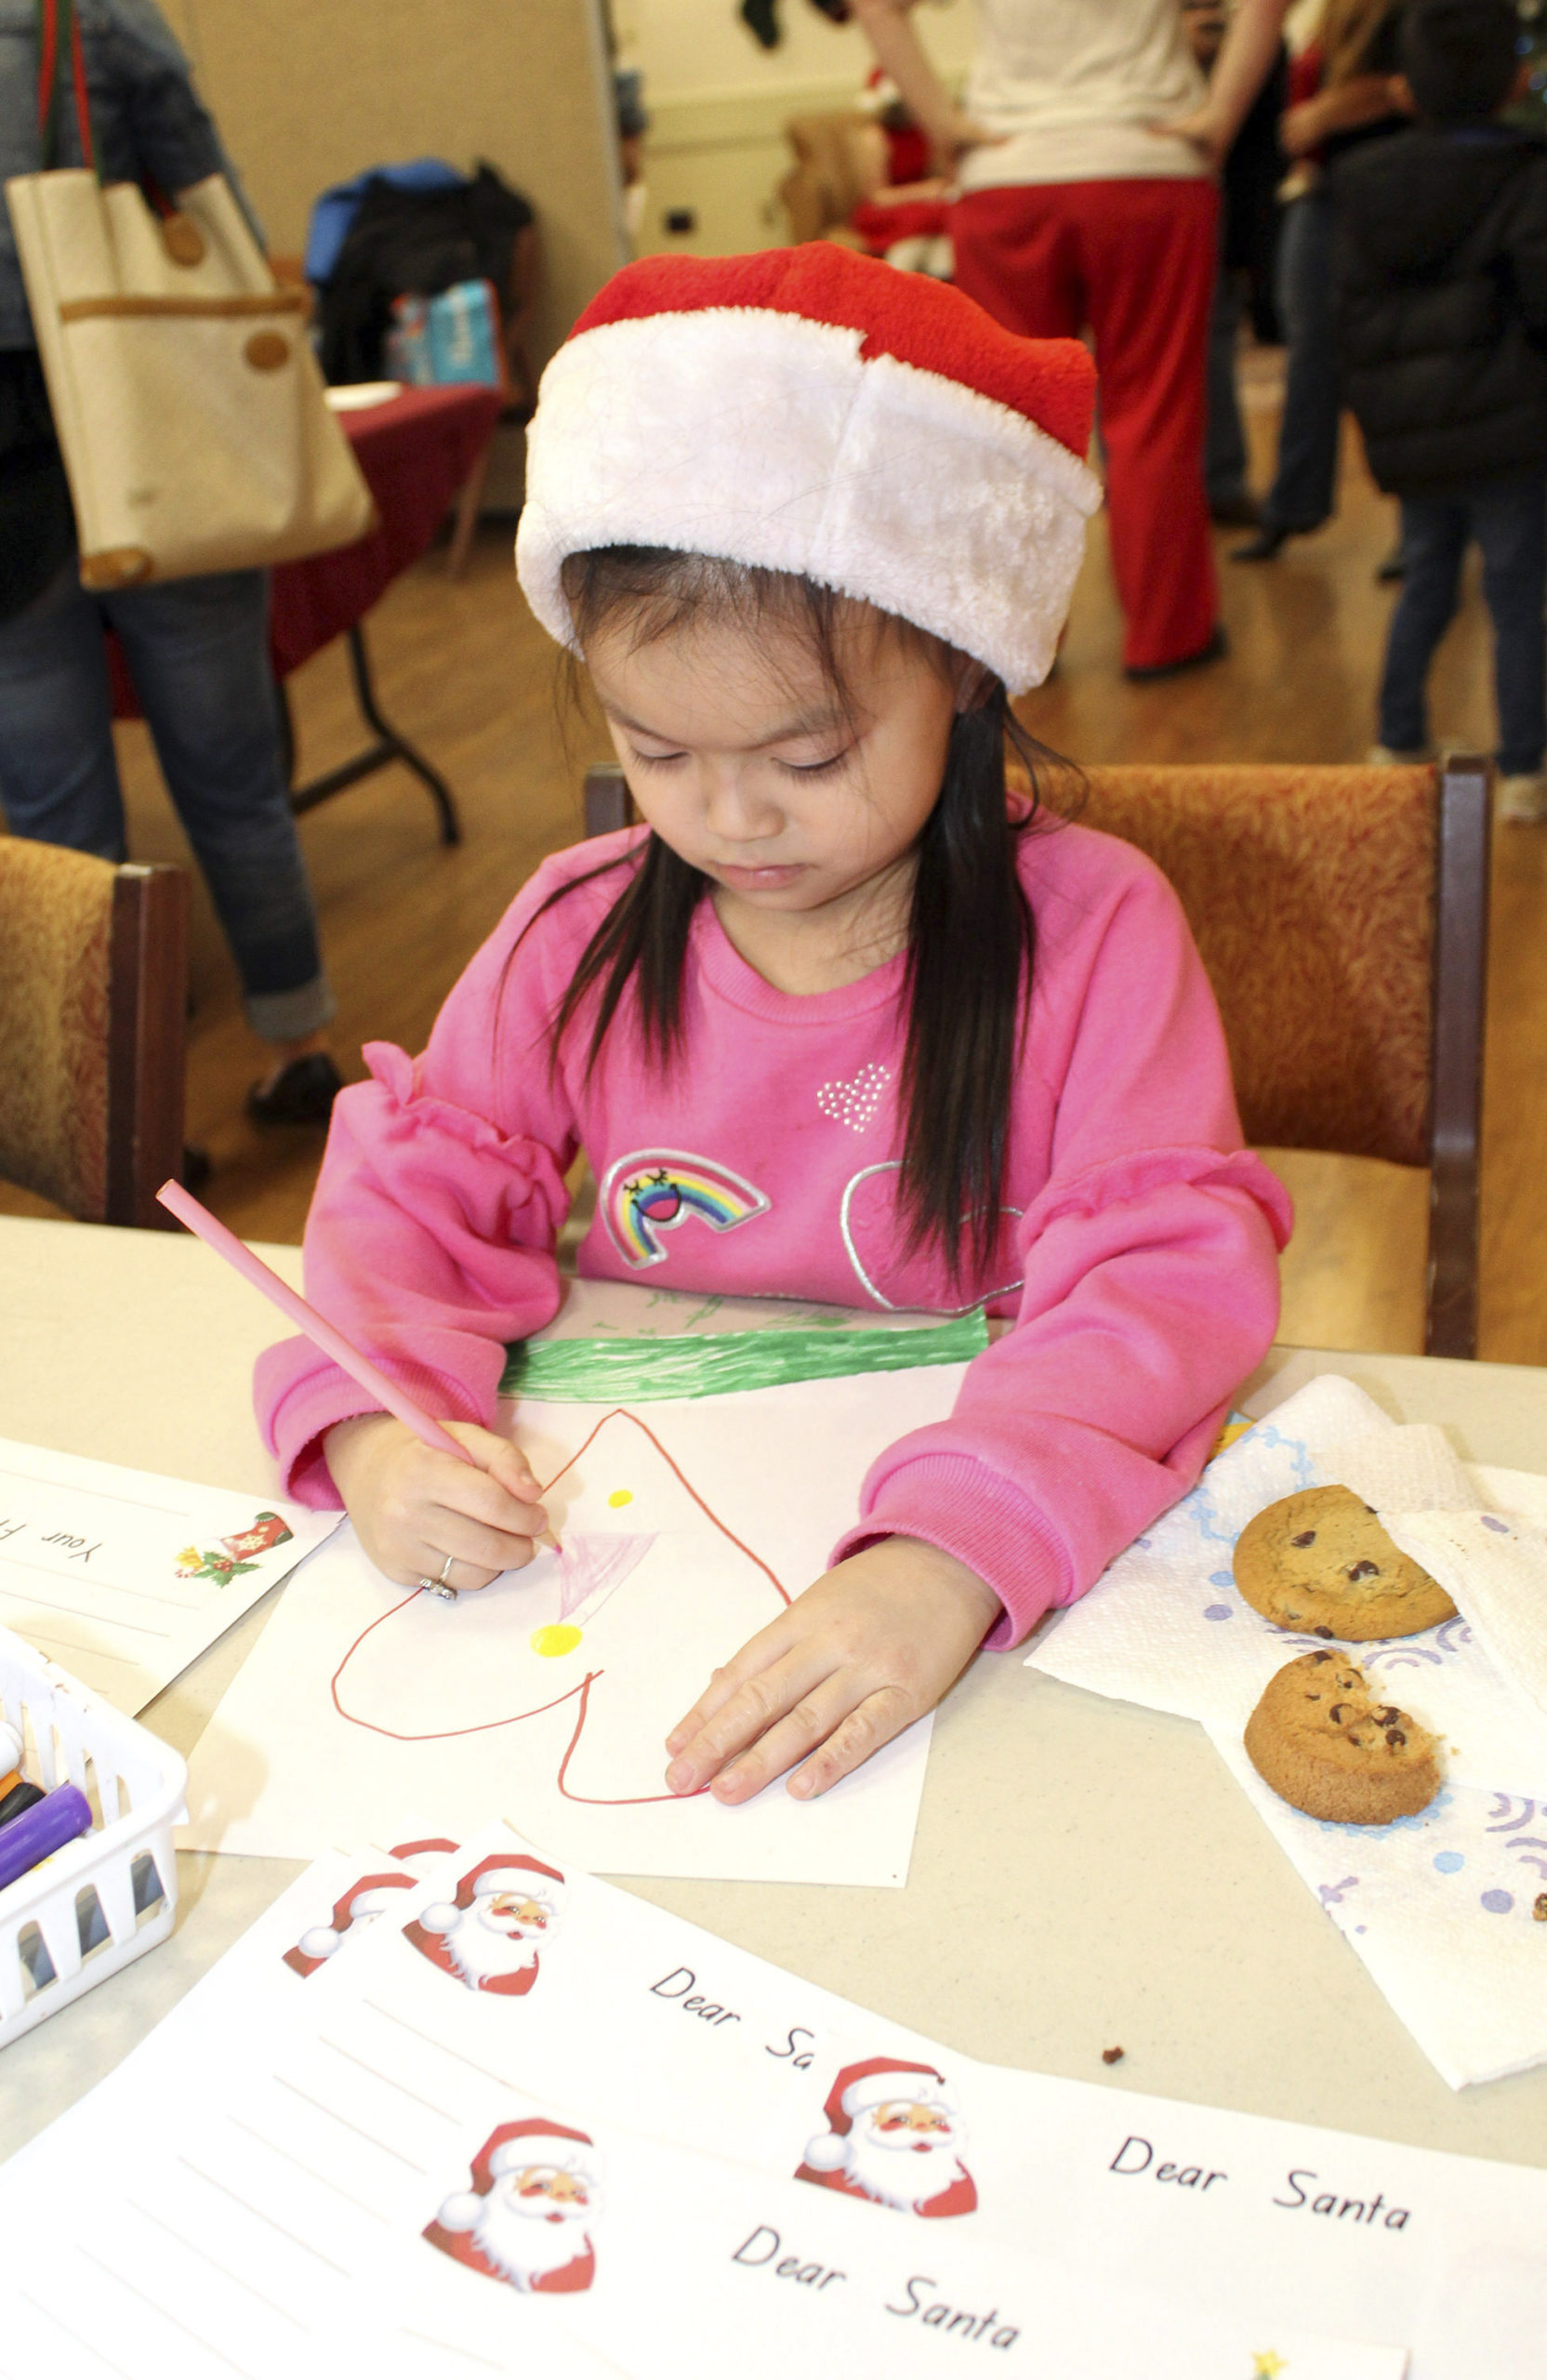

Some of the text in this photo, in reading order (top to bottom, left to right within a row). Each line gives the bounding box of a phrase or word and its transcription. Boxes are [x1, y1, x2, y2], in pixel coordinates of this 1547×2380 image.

[41, 1532, 103, 1563] Your
[649, 1967, 741, 2026] Dear
[1109, 2135, 1410, 2230] Dear Santa
[732, 2225, 1020, 2351] Dear Santa
